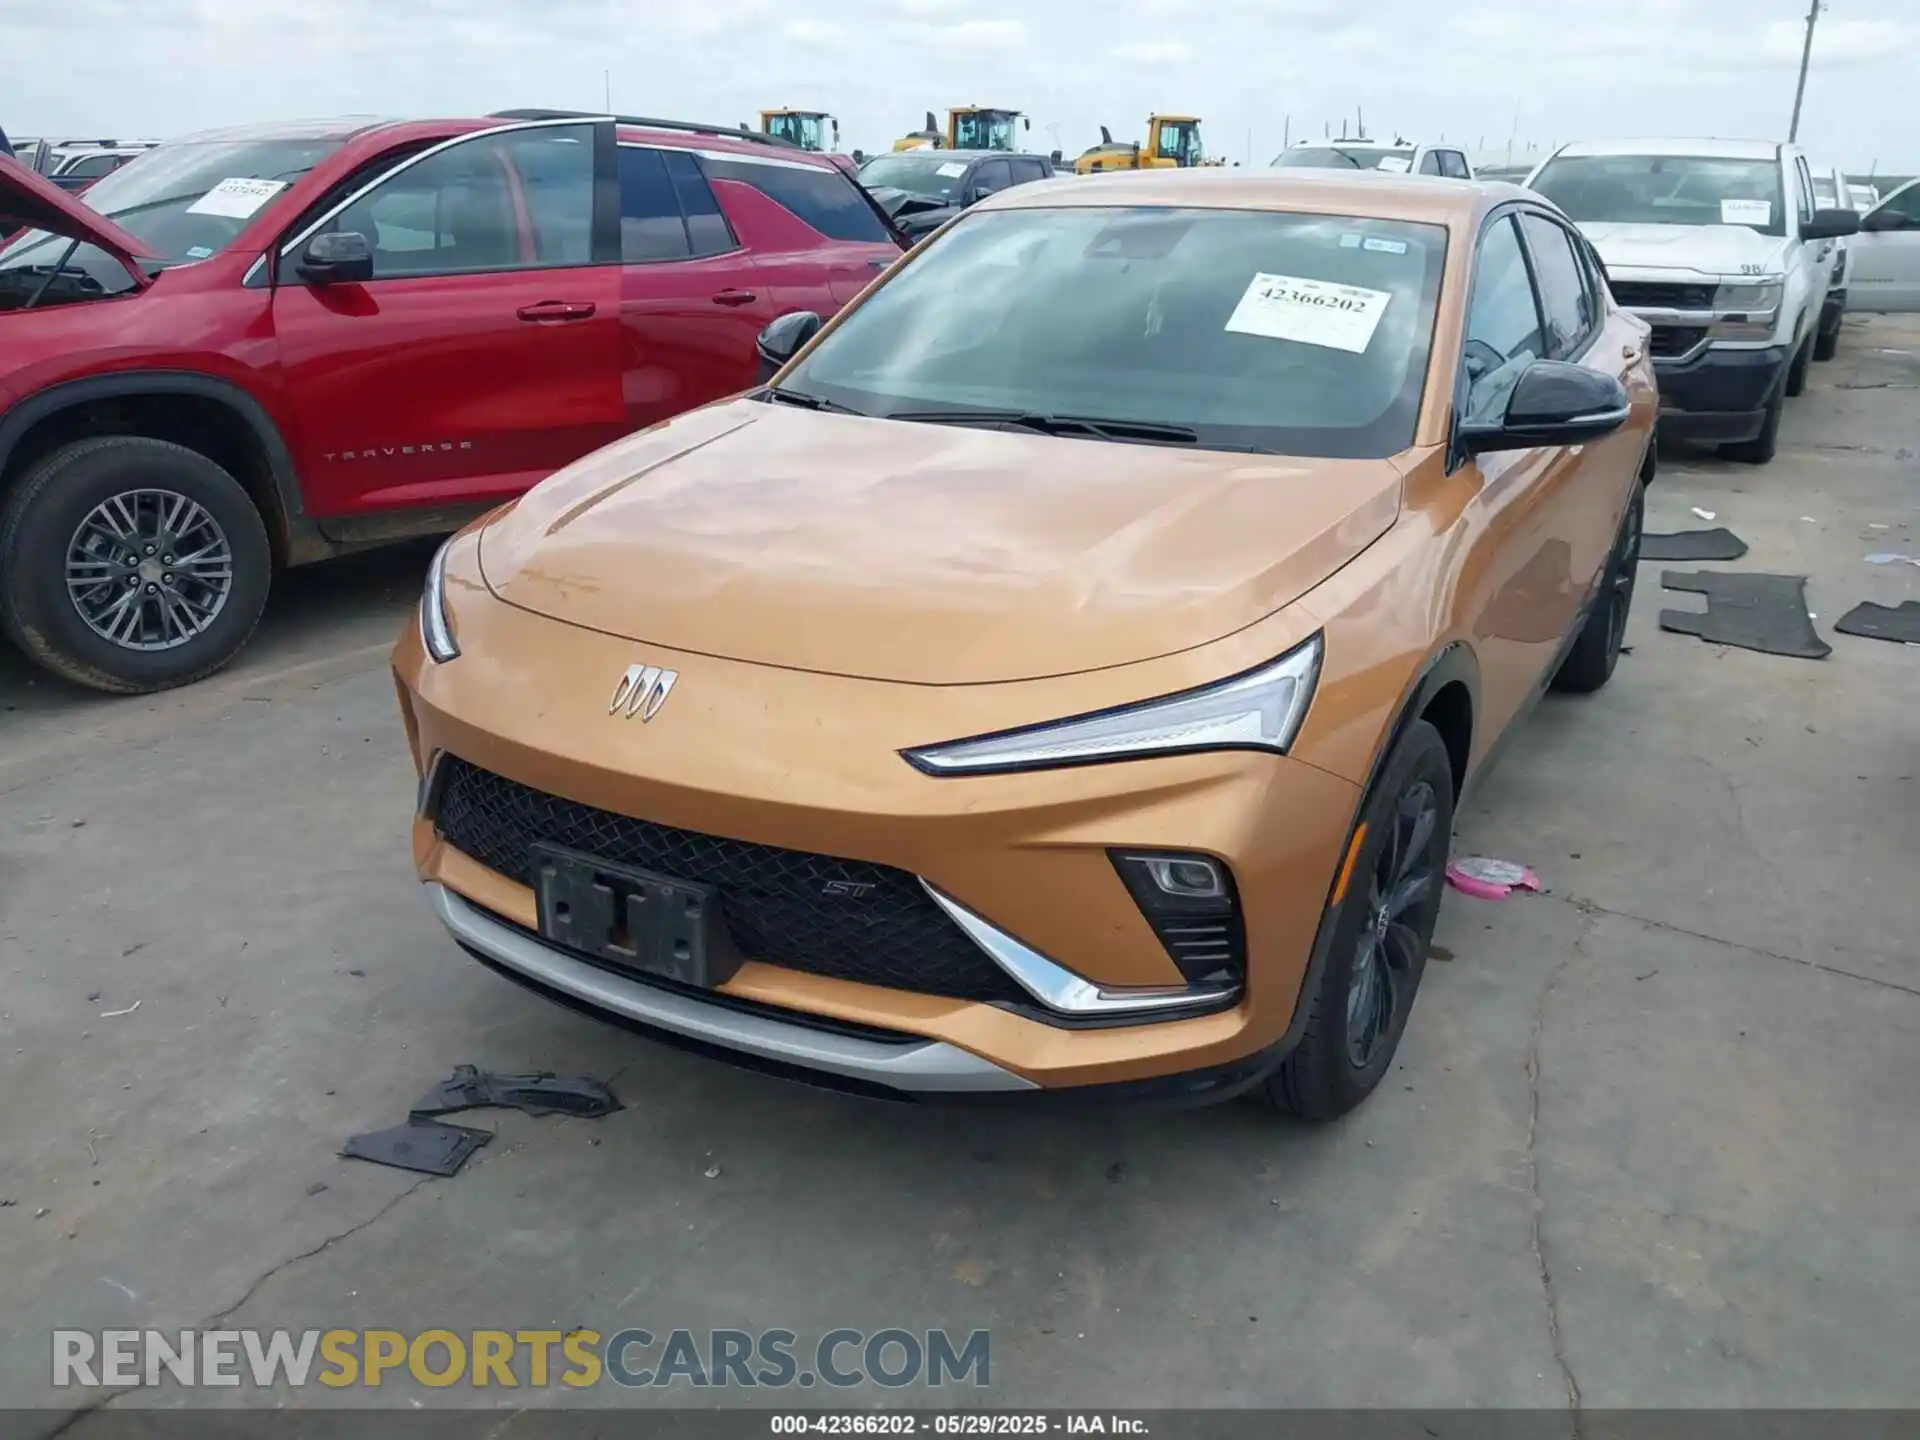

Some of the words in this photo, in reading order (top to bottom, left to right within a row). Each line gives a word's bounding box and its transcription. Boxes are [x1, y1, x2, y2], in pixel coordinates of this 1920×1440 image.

[1259, 287, 1367, 313] 42366202
[323, 441, 472, 461] TRAVERSE
[821, 880, 876, 898] ST
